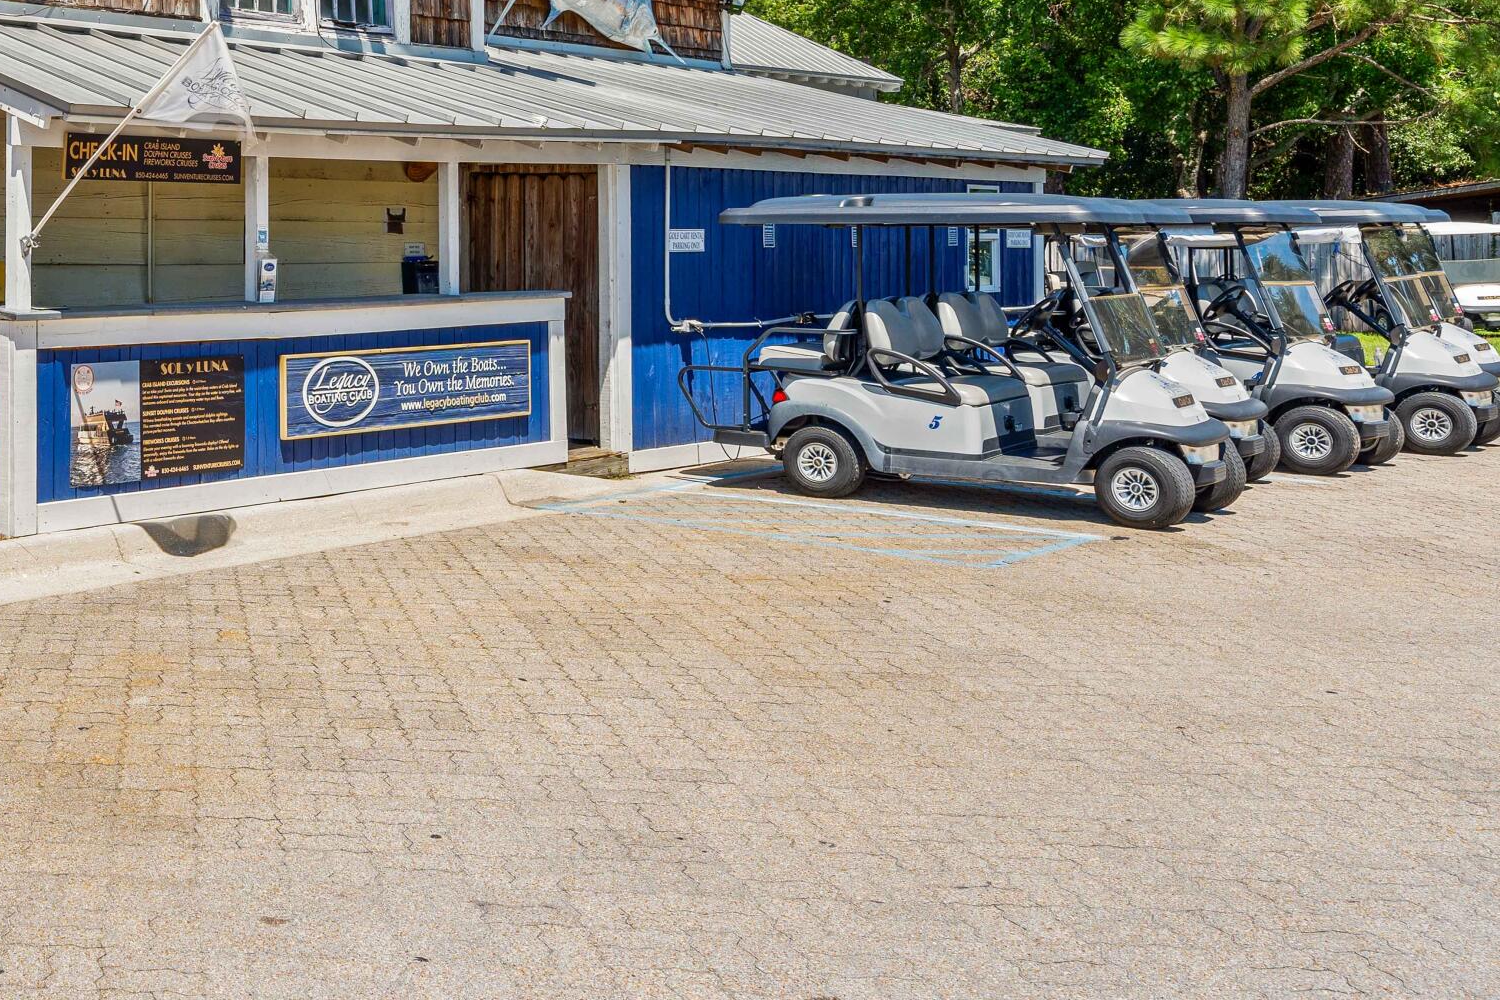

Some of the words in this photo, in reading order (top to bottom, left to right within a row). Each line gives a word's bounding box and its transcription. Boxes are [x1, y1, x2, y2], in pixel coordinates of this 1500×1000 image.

[143, 141, 159, 150] CRAB
[160, 143, 180, 151] ISLAND
[143, 150, 169, 158] DOLPHIN
[170, 151, 192, 159] CRUISES
[143, 159, 175, 167] FIREWORKS
[177, 160, 198, 168] CRUISES
[71, 167, 90, 177] SL
[100, 168, 127, 178] LUNA
[160, 361, 185, 376] SOL
[185, 363, 195, 374] y
[196, 359, 229, 373] LUNA
[403, 362, 421, 377] We
[423, 361, 450, 376] Own
[452, 356, 468, 374] the
[471, 357, 507, 372] Boats...
[312, 366, 372, 395] Legacy
[394, 380, 416, 397] You
[418, 378, 444, 393] Own
[446, 373, 463, 391] the
[465, 372, 515, 390] Memories.
[308, 391, 348, 405] BOATING
[349, 390, 373, 402] CLUB
[401, 392, 507, 411] www.legacyboatingclub.com
[928, 415, 943, 430] 5
